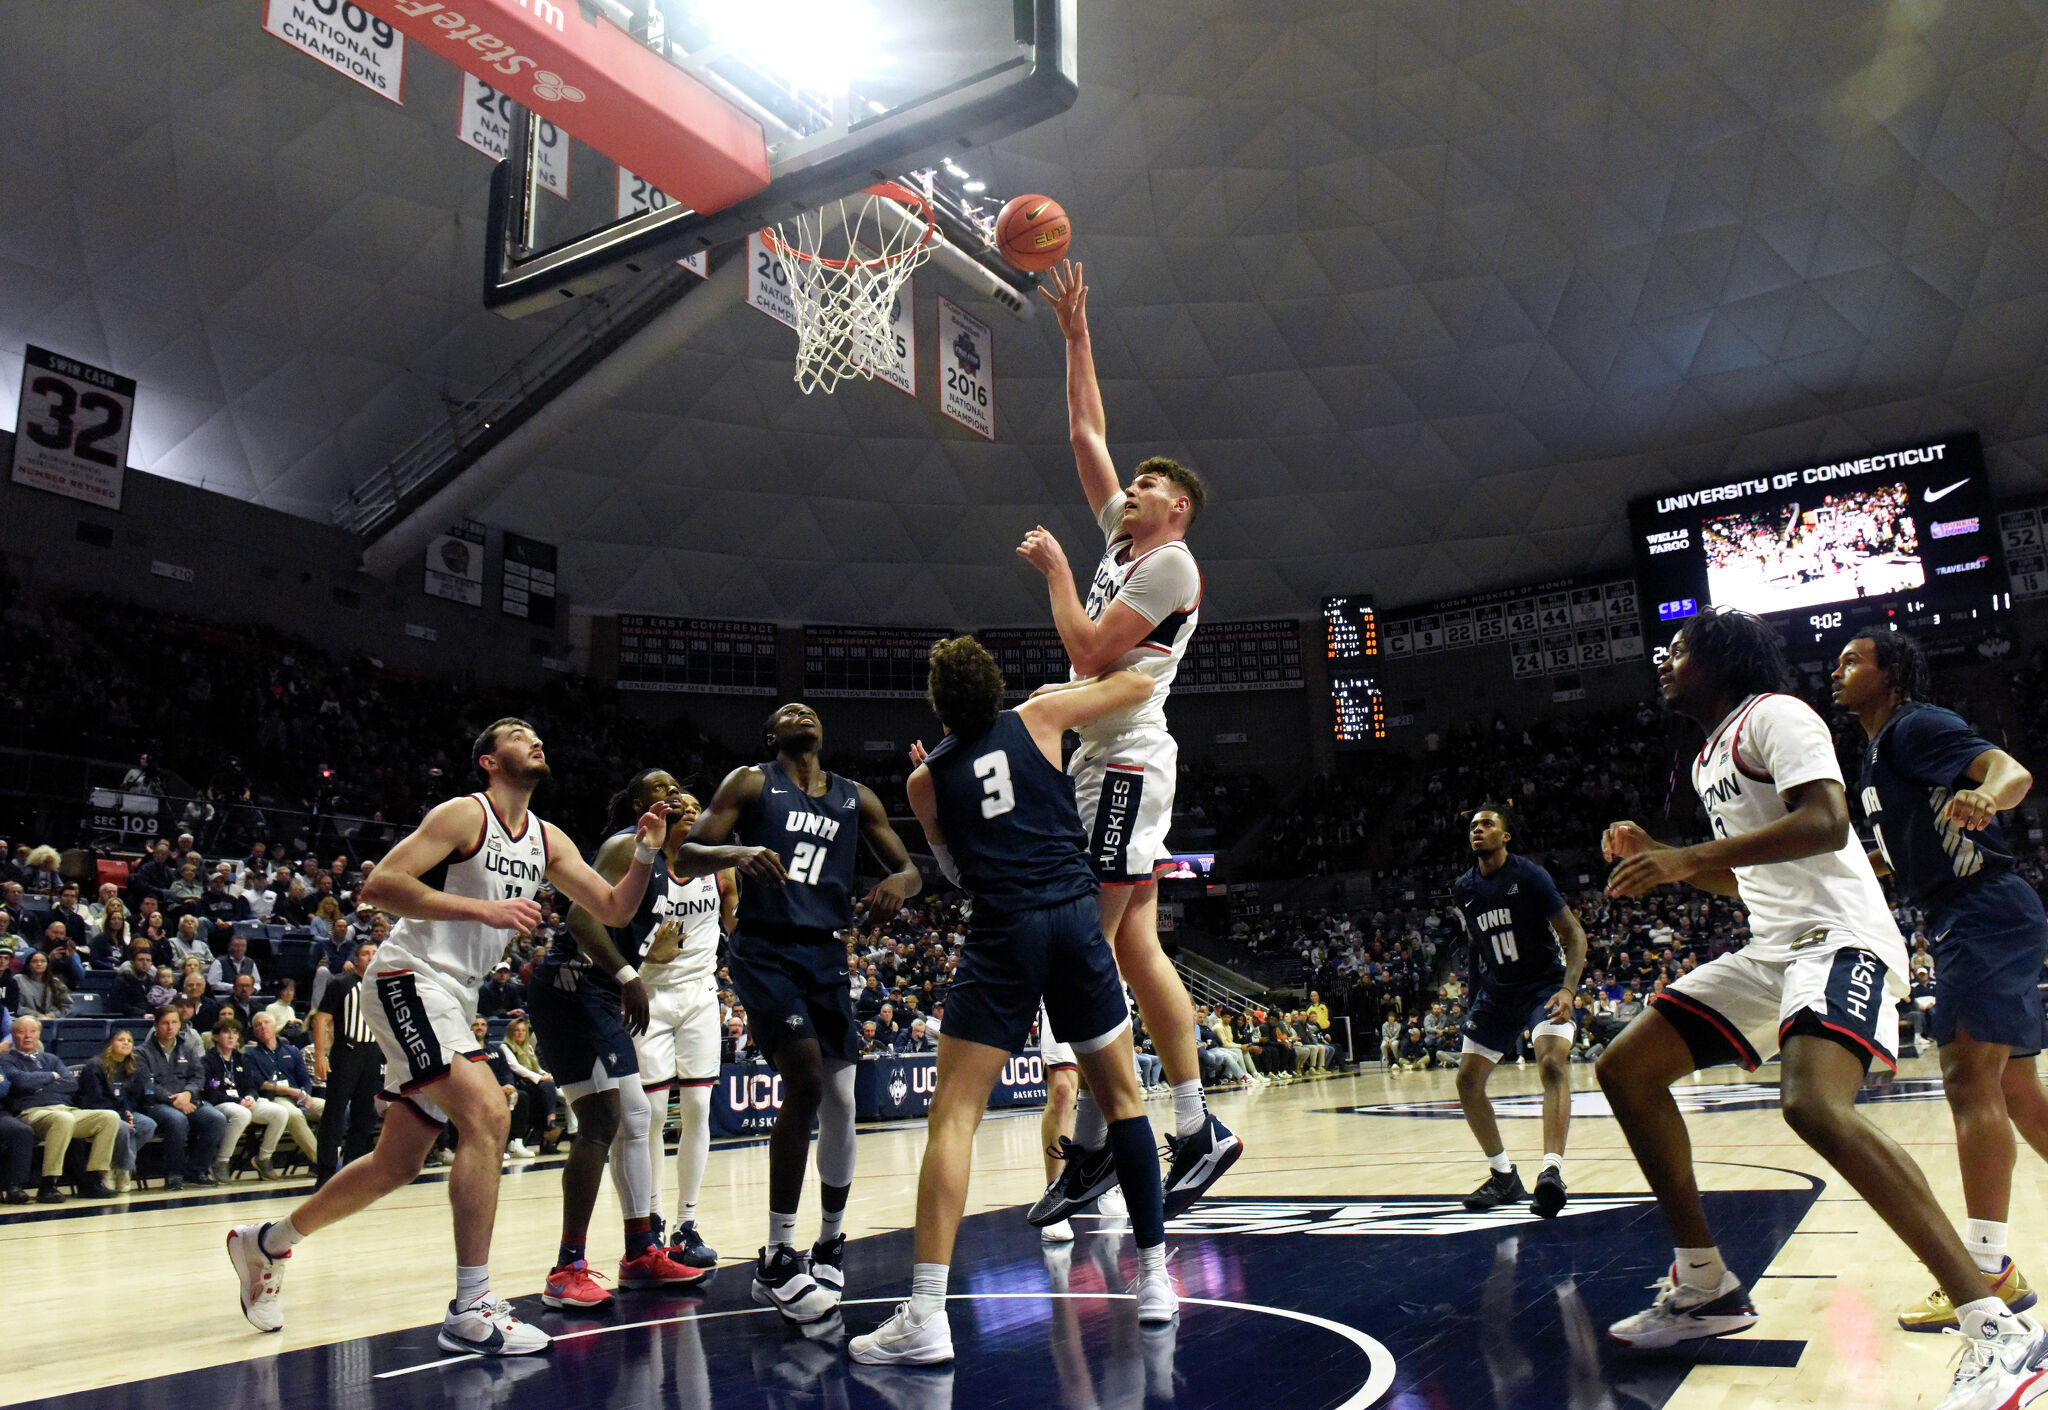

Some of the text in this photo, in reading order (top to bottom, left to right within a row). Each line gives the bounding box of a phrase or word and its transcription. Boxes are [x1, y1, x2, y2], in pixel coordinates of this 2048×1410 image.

[292, 5, 381, 67] NATIONAL
[283, 22, 386, 89] CHAMPIONS
[1035, 224, 1066, 245] ELITE
[49, 355, 116, 388] SWIN CASH
[947, 367, 988, 407] 2016
[949, 392, 986, 420] NATIONAL
[26, 376, 124, 469] 32
[946, 404, 989, 434] CHAMPIONS
[1657, 444, 1947, 513] UNIVERSITY OF CONNECTICUT
[1646, 528, 1689, 544] WELLS
[1649, 539, 1690, 555] FARGO
[2008, 529, 2035, 546] 52
[1936, 561, 1981, 575] TRAVELERS
[1544, 609, 1566, 624] 44
[1611, 598, 1634, 614] 42
[651, 618, 685, 629] EAST
[691, 620, 774, 633] CONFERENCE
[1199, 621, 1291, 633] CHAMPIONSHIP
[1479, 623, 1501, 638] 25
[1512, 615, 1534, 631] 42
[1810, 613, 1842, 631] 9:02
[1449, 626, 1470, 641] 22
[1517, 655, 1539, 670] 24
[1551, 650, 1569, 665] 13
[1582, 645, 1604, 660] 22
[973, 749, 1017, 820] 3
[1702, 772, 1742, 812] ONN
[94, 815, 159, 833] SEC 109
[785, 811, 840, 842] UNH
[1099, 779, 1131, 872] HUSKIES
[485, 851, 541, 882] UCONN
[787, 841, 828, 886] 21
[665, 898, 716, 917] CONN
[1476, 908, 1512, 932] UNH
[1491, 931, 1520, 965] 14
[386, 980, 432, 1071] HUSKIES
[1001, 1055, 1044, 1087] UCO
